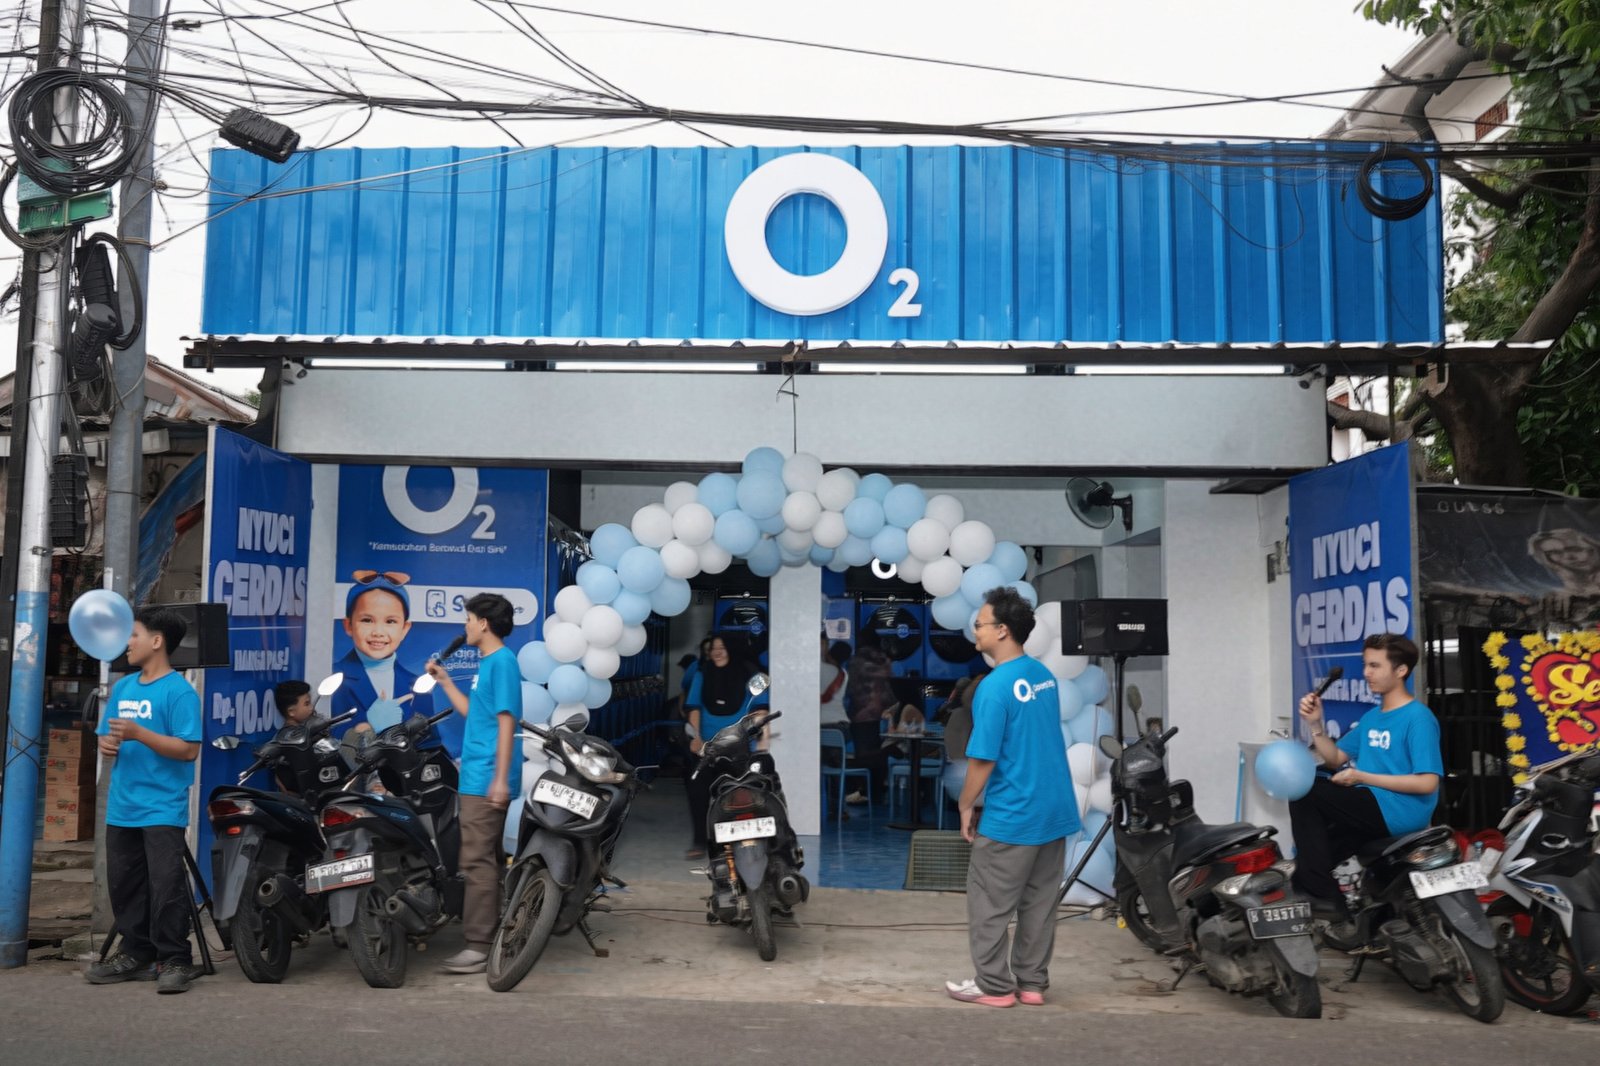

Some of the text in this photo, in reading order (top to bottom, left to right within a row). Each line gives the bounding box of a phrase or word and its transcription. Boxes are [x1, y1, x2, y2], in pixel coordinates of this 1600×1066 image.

[238, 507, 294, 555] NYUCI
[1312, 521, 1380, 580] NYUCI
[213, 559, 306, 616] CERDAS
[1295, 576, 1410, 647] CERDAS
